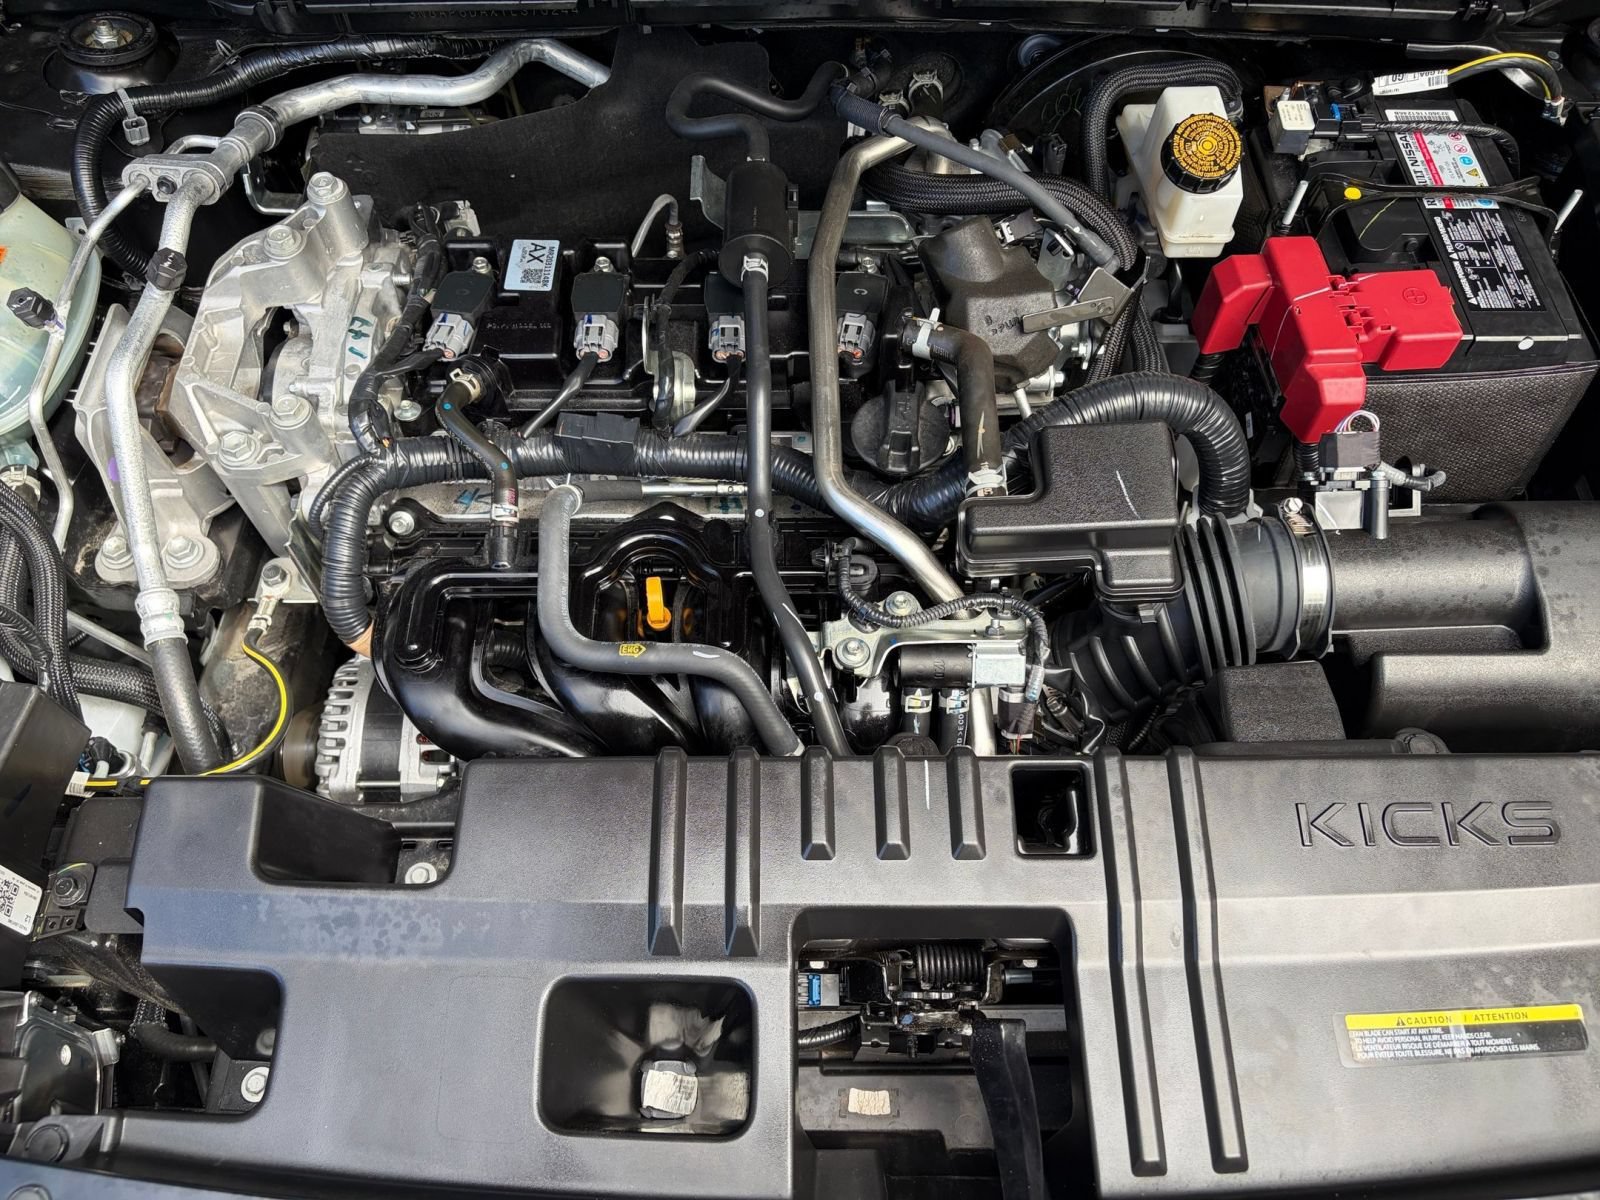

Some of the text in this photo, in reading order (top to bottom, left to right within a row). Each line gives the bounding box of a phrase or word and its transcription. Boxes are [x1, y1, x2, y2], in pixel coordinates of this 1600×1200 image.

[526, 242, 547, 264] AX
[1295, 801, 1561, 847] KICKS
[1406, 1011, 1528, 1025] CAUTION ATTENTION
